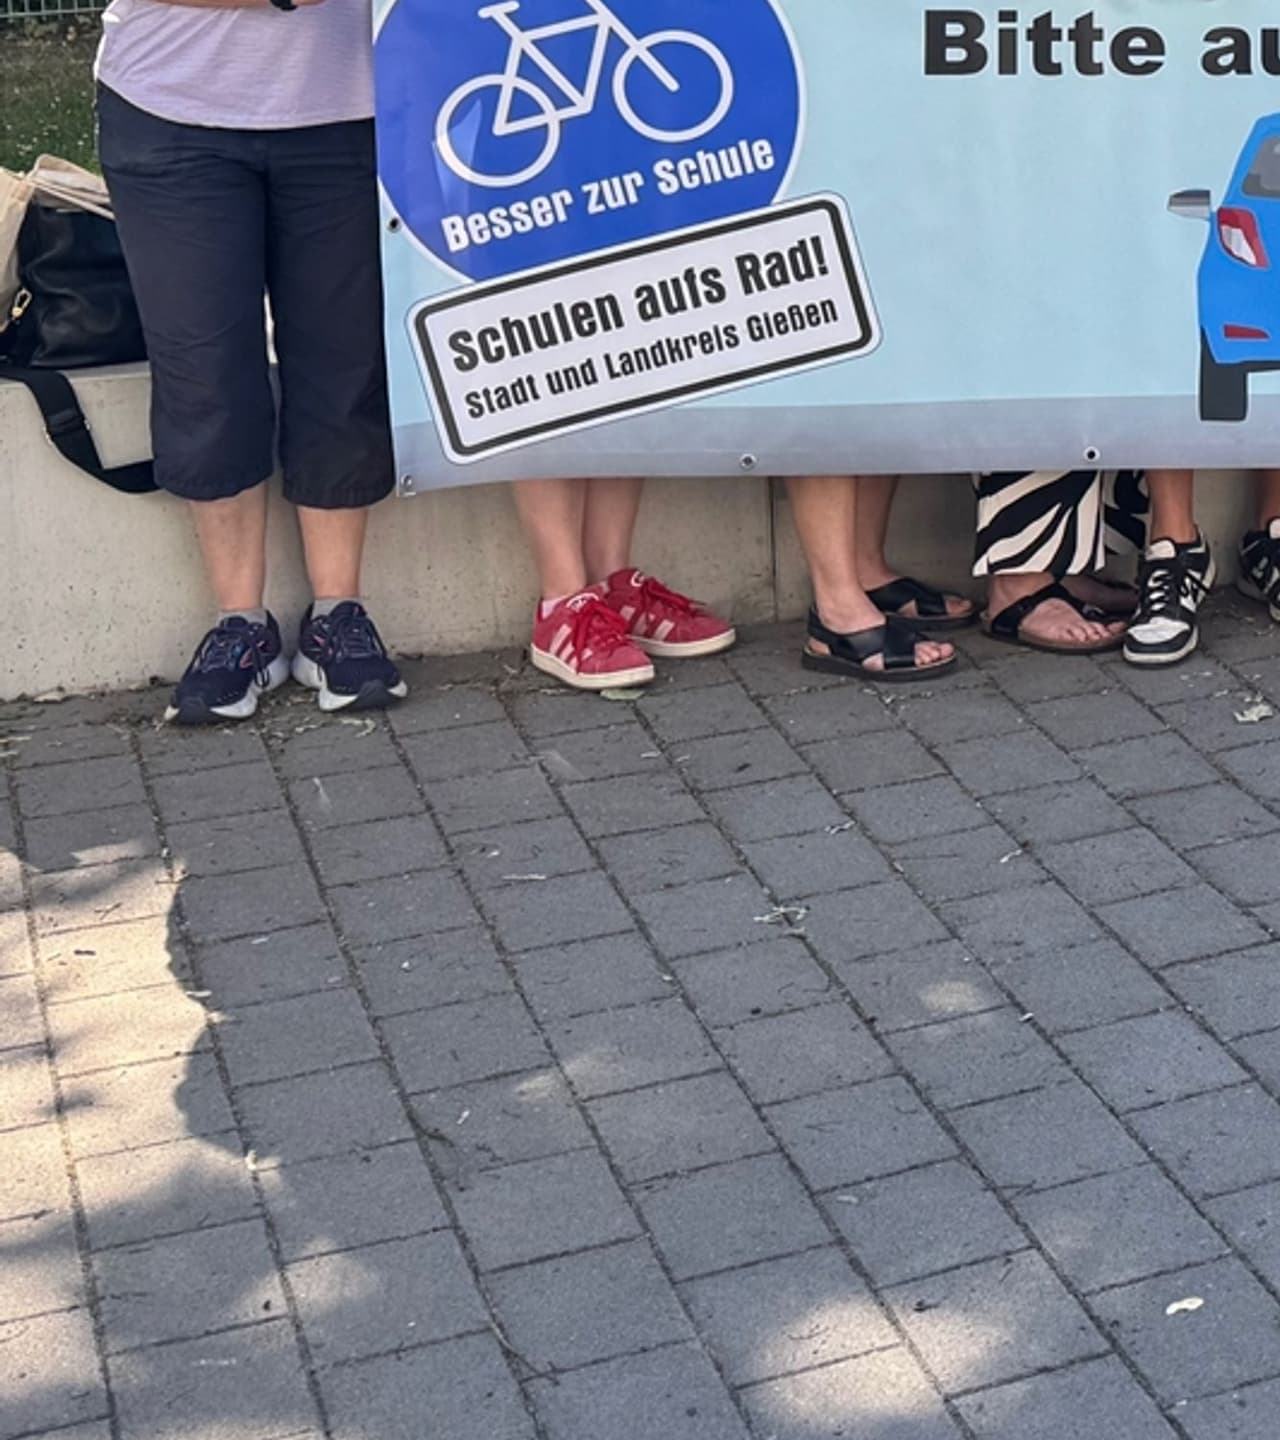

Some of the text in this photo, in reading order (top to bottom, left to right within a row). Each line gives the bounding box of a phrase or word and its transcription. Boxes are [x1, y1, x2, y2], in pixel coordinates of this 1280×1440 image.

[923, 9, 1167, 77] Bitte
[440, 137, 776, 253] Besser zur Schule
[447, 234, 830, 373] Schulen aufs Rad!
[464, 298, 839, 419] Stadt und Landkreis Gießen
